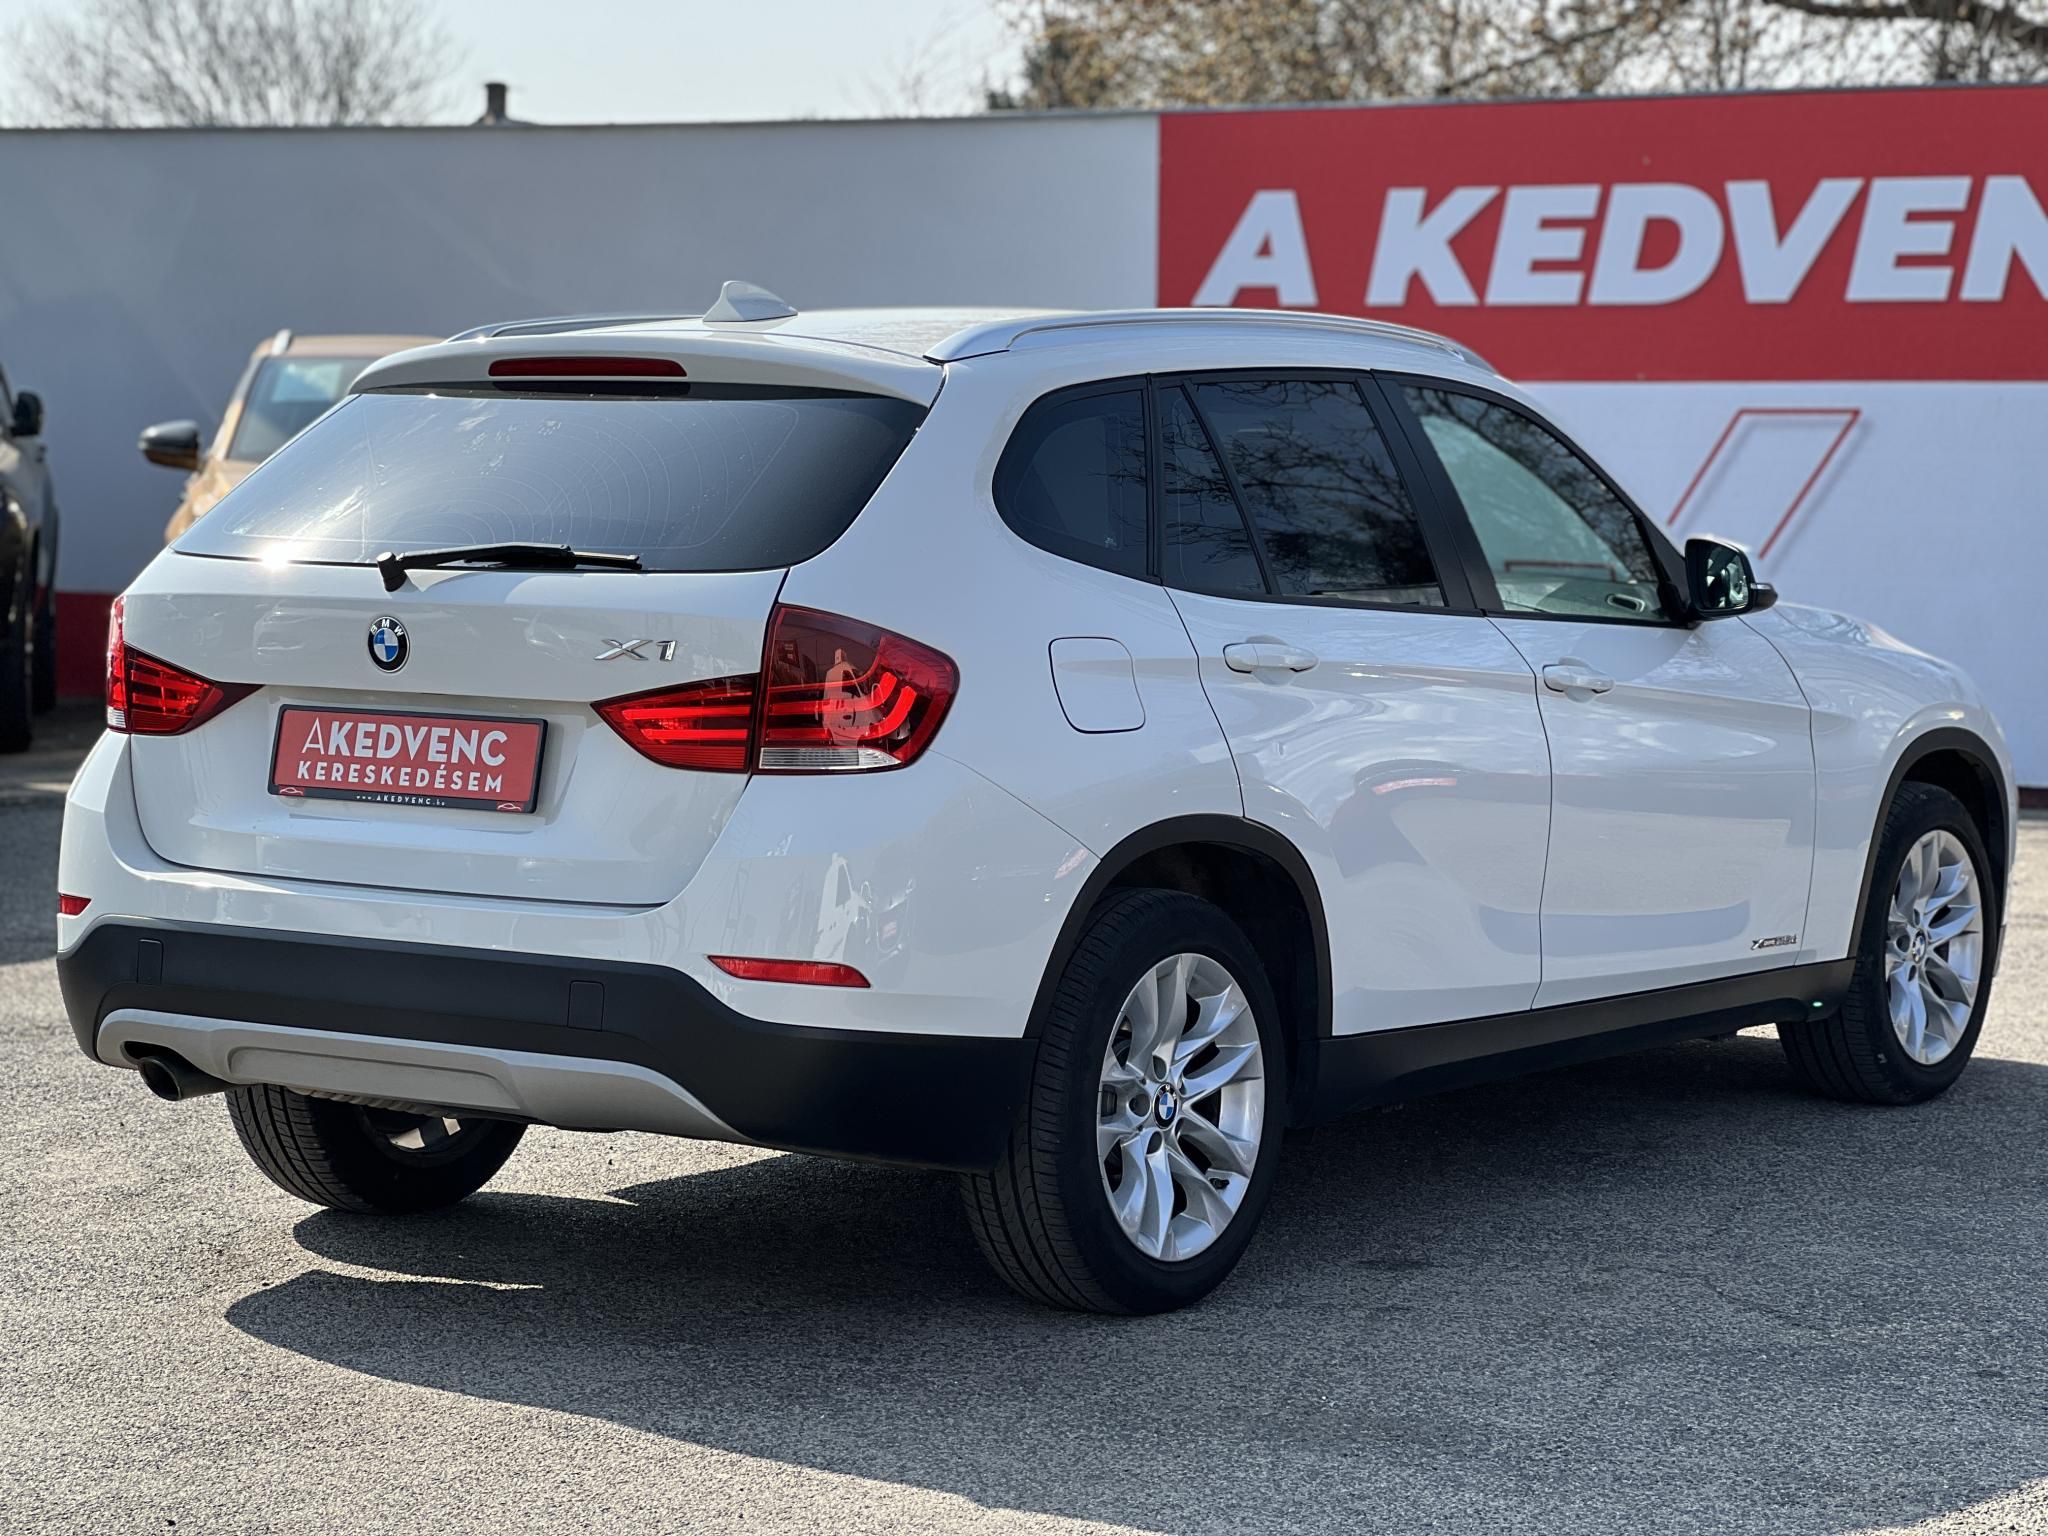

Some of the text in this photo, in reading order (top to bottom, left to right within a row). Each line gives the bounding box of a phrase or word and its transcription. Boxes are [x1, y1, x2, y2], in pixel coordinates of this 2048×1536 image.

[1191, 189, 1318, 306] A
[370, 618, 404, 636] BMW
[594, 639, 677, 661] X1
[297, 760, 503, 793] KERESKEDÉSEM
